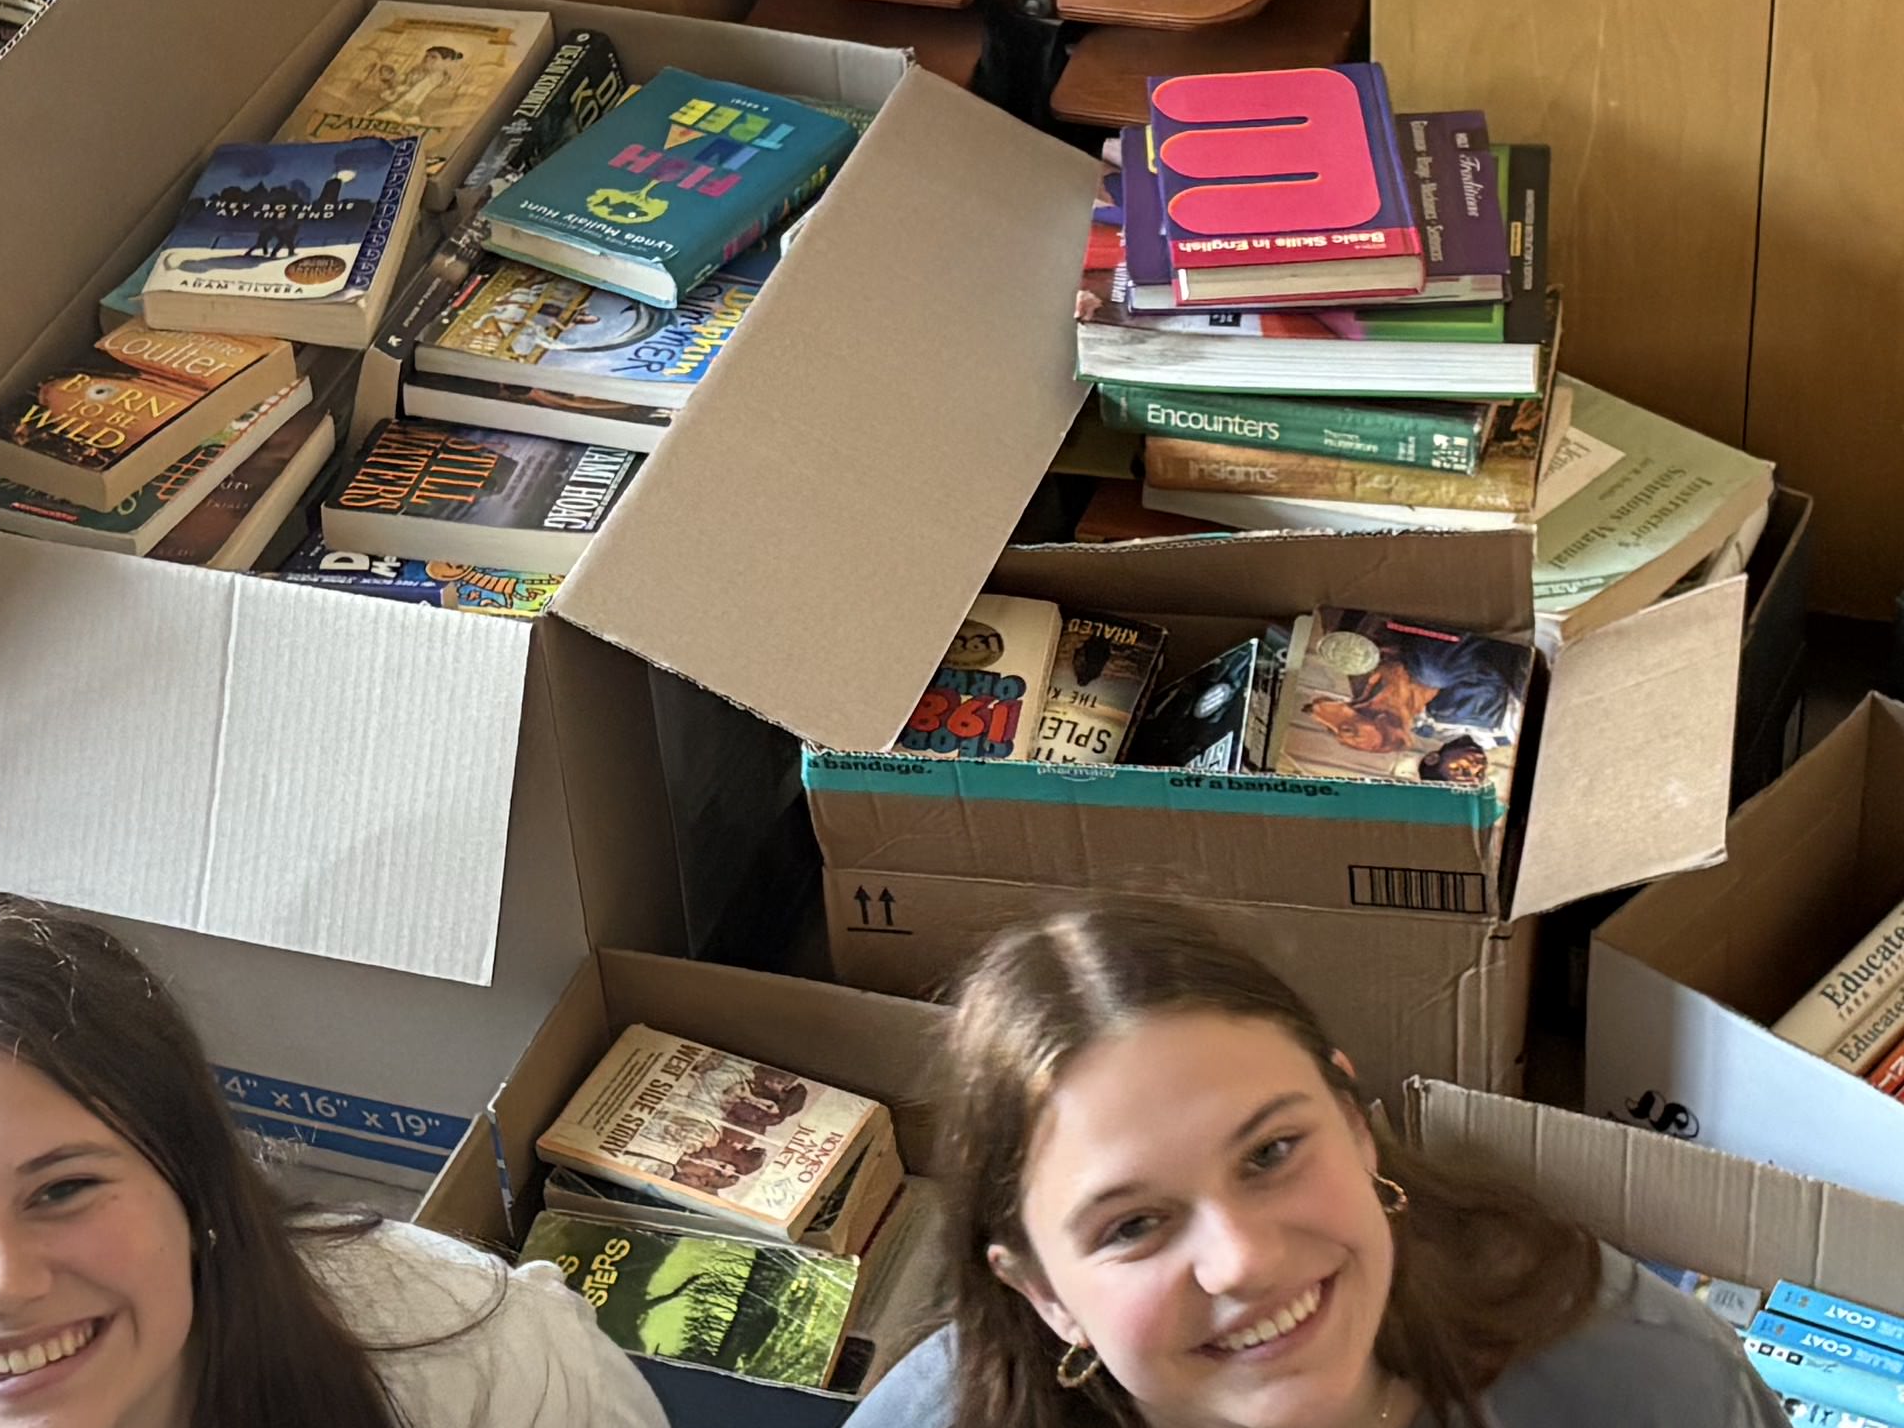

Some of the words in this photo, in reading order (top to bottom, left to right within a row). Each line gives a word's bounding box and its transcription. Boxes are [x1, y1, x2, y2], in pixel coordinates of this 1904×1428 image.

[549, 43, 588, 74] DEAN
[512, 72, 563, 118] KOONTZ
[668, 97, 796, 150] TREE
[607, 142, 742, 200] FISH
[203, 200, 251, 211] THEY
[260, 202, 313, 212] BOTH
[324, 201, 355, 212] DIE
[216, 209, 239, 217] AT
[252, 210, 286, 220] THE
[297, 211, 335, 220] END
[519, 198, 561, 223] Hunt
[562, 210, 621, 241] Mullaly
[1274, 235, 1328, 249] Skills
[1331, 231, 1386, 246] Basic
[623, 231, 675, 256] Lynda
[1177, 239, 1250, 253] English
[1251, 239, 1271, 250] in
[179, 279, 230, 291] ADAM
[662, 286, 756, 376] Dolphin
[105, 332, 236, 379] Coulter
[17, 404, 127, 451] WILD
[65, 396, 105, 421] TO
[108, 410, 140, 429] BE
[1146, 403, 1281, 441] Encounters
[337, 421, 449, 514] WATERS
[408, 433, 510, 507] STILL
[1188, 460, 1279, 484] Insights
[542, 477, 608, 532] HOAG
[1608, 466, 1687, 521] Solutions
[1617, 476, 1713, 549] Instructor's
[1547, 524, 1617, 571] Manual
[1067, 617, 1138, 647] KHALED
[1069, 689, 1098, 708] THE
[821, 754, 932, 776] bandage.
[1223, 776, 1340, 799] bandage.
[658, 1043, 704, 1082] WEST
[269, 1090, 294, 1110] x
[299, 1092, 349, 1119] 16"
[361, 1109, 384, 1130] x
[390, 1111, 441, 1137] 19"
[635, 1078, 673, 1115] SIDE
[597, 1112, 644, 1159] STORY
[771, 1122, 817, 1170] JULIET
[796, 1131, 844, 1184] ROMEO
[1823, 1302, 1876, 1330] COAT
[1800, 1331, 1854, 1358] COAT
